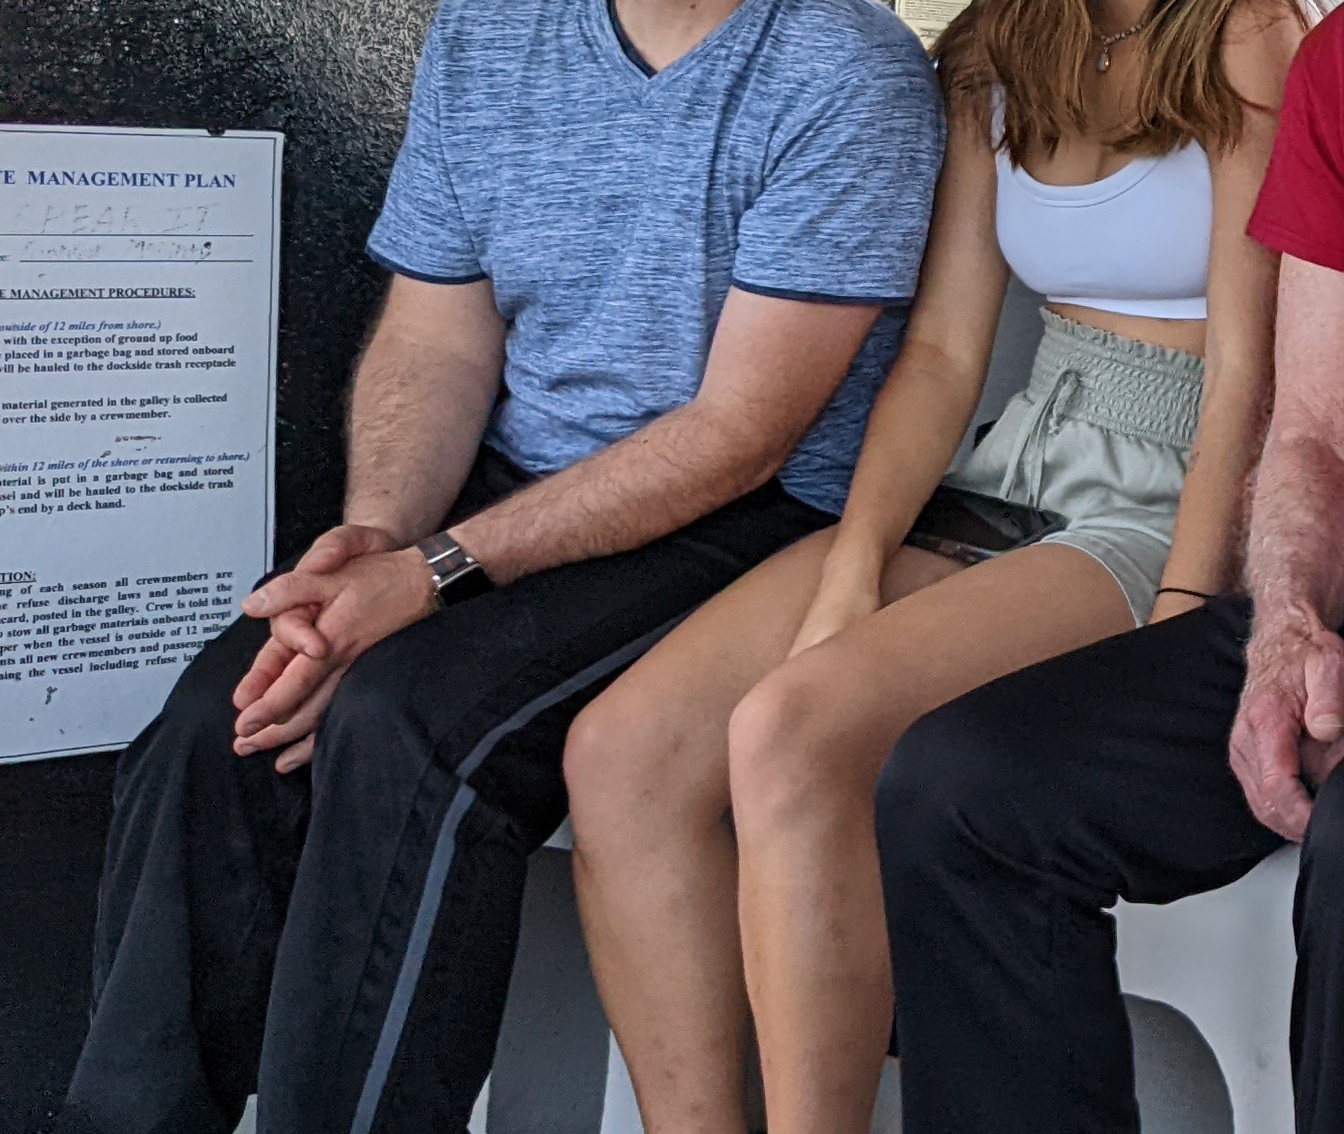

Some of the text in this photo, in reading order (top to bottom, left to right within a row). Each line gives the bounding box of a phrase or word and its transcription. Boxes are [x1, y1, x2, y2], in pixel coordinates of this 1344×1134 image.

[0, 170, 235, 187] E MANAGEMENT PLAN
[10, 287, 196, 297] MANAGEMENT PROCEDURES:
[38, 322, 54, 332] of
[53, 321, 66, 330] 12
[68, 321, 95, 330] miles
[97, 321, 124, 332] from
[126, 320, 162, 331] shore.)
[4, 332, 197, 346] with the exception of ground up food
[4, 345, 234, 362] placed in garbage bag and stored onboard
[17, 359, 236, 372] be hauled to the dockside trash receptacle
[2, 393, 226, 410] material generated in the galley collected
[2, 410, 171, 424] over the side by crewmember.
[32, 461, 44, 470] 12
[47, 460, 74, 469] miles
[78, 459, 90, 469] of
[91, 458, 108, 467] the
[110, 457, 138, 466] shore
[155, 455, 203, 465] returning
[205, 454, 215, 462] to
[217, 451, 250, 462] shore.)
[52, 465, 234, 486] put in garbage bag and stored
[20, 479, 234, 499] and will be hauled to the dockside trash
[18, 500, 124, 514] end by deck hand.
[20, 571, 232, 594] of each season all crewmembers are
[16, 583, 232, 608] refuse discharge laws and shown the
[32, 609, 67, 624] posted
[71, 609, 81, 617] in
[85, 607, 102, 616] the
[104, 605, 138, 617] galley.
[145, 602, 173, 611] Crew
[188, 598, 208, 607] told
[211, 596, 232, 605] that
[7, 610, 231, 636] stow all garbage materials onboard except
[23, 640, 52, 649] when
[58, 637, 74, 646] the
[79, 633, 110, 644] vessel
[127, 629, 165, 640] outside
[170, 627, 180, 636] of
[186, 625, 197, 634] 12
[19, 642, 159, 663] all new crewmembers and
[28, 656, 177, 677] the vessel including refuse
